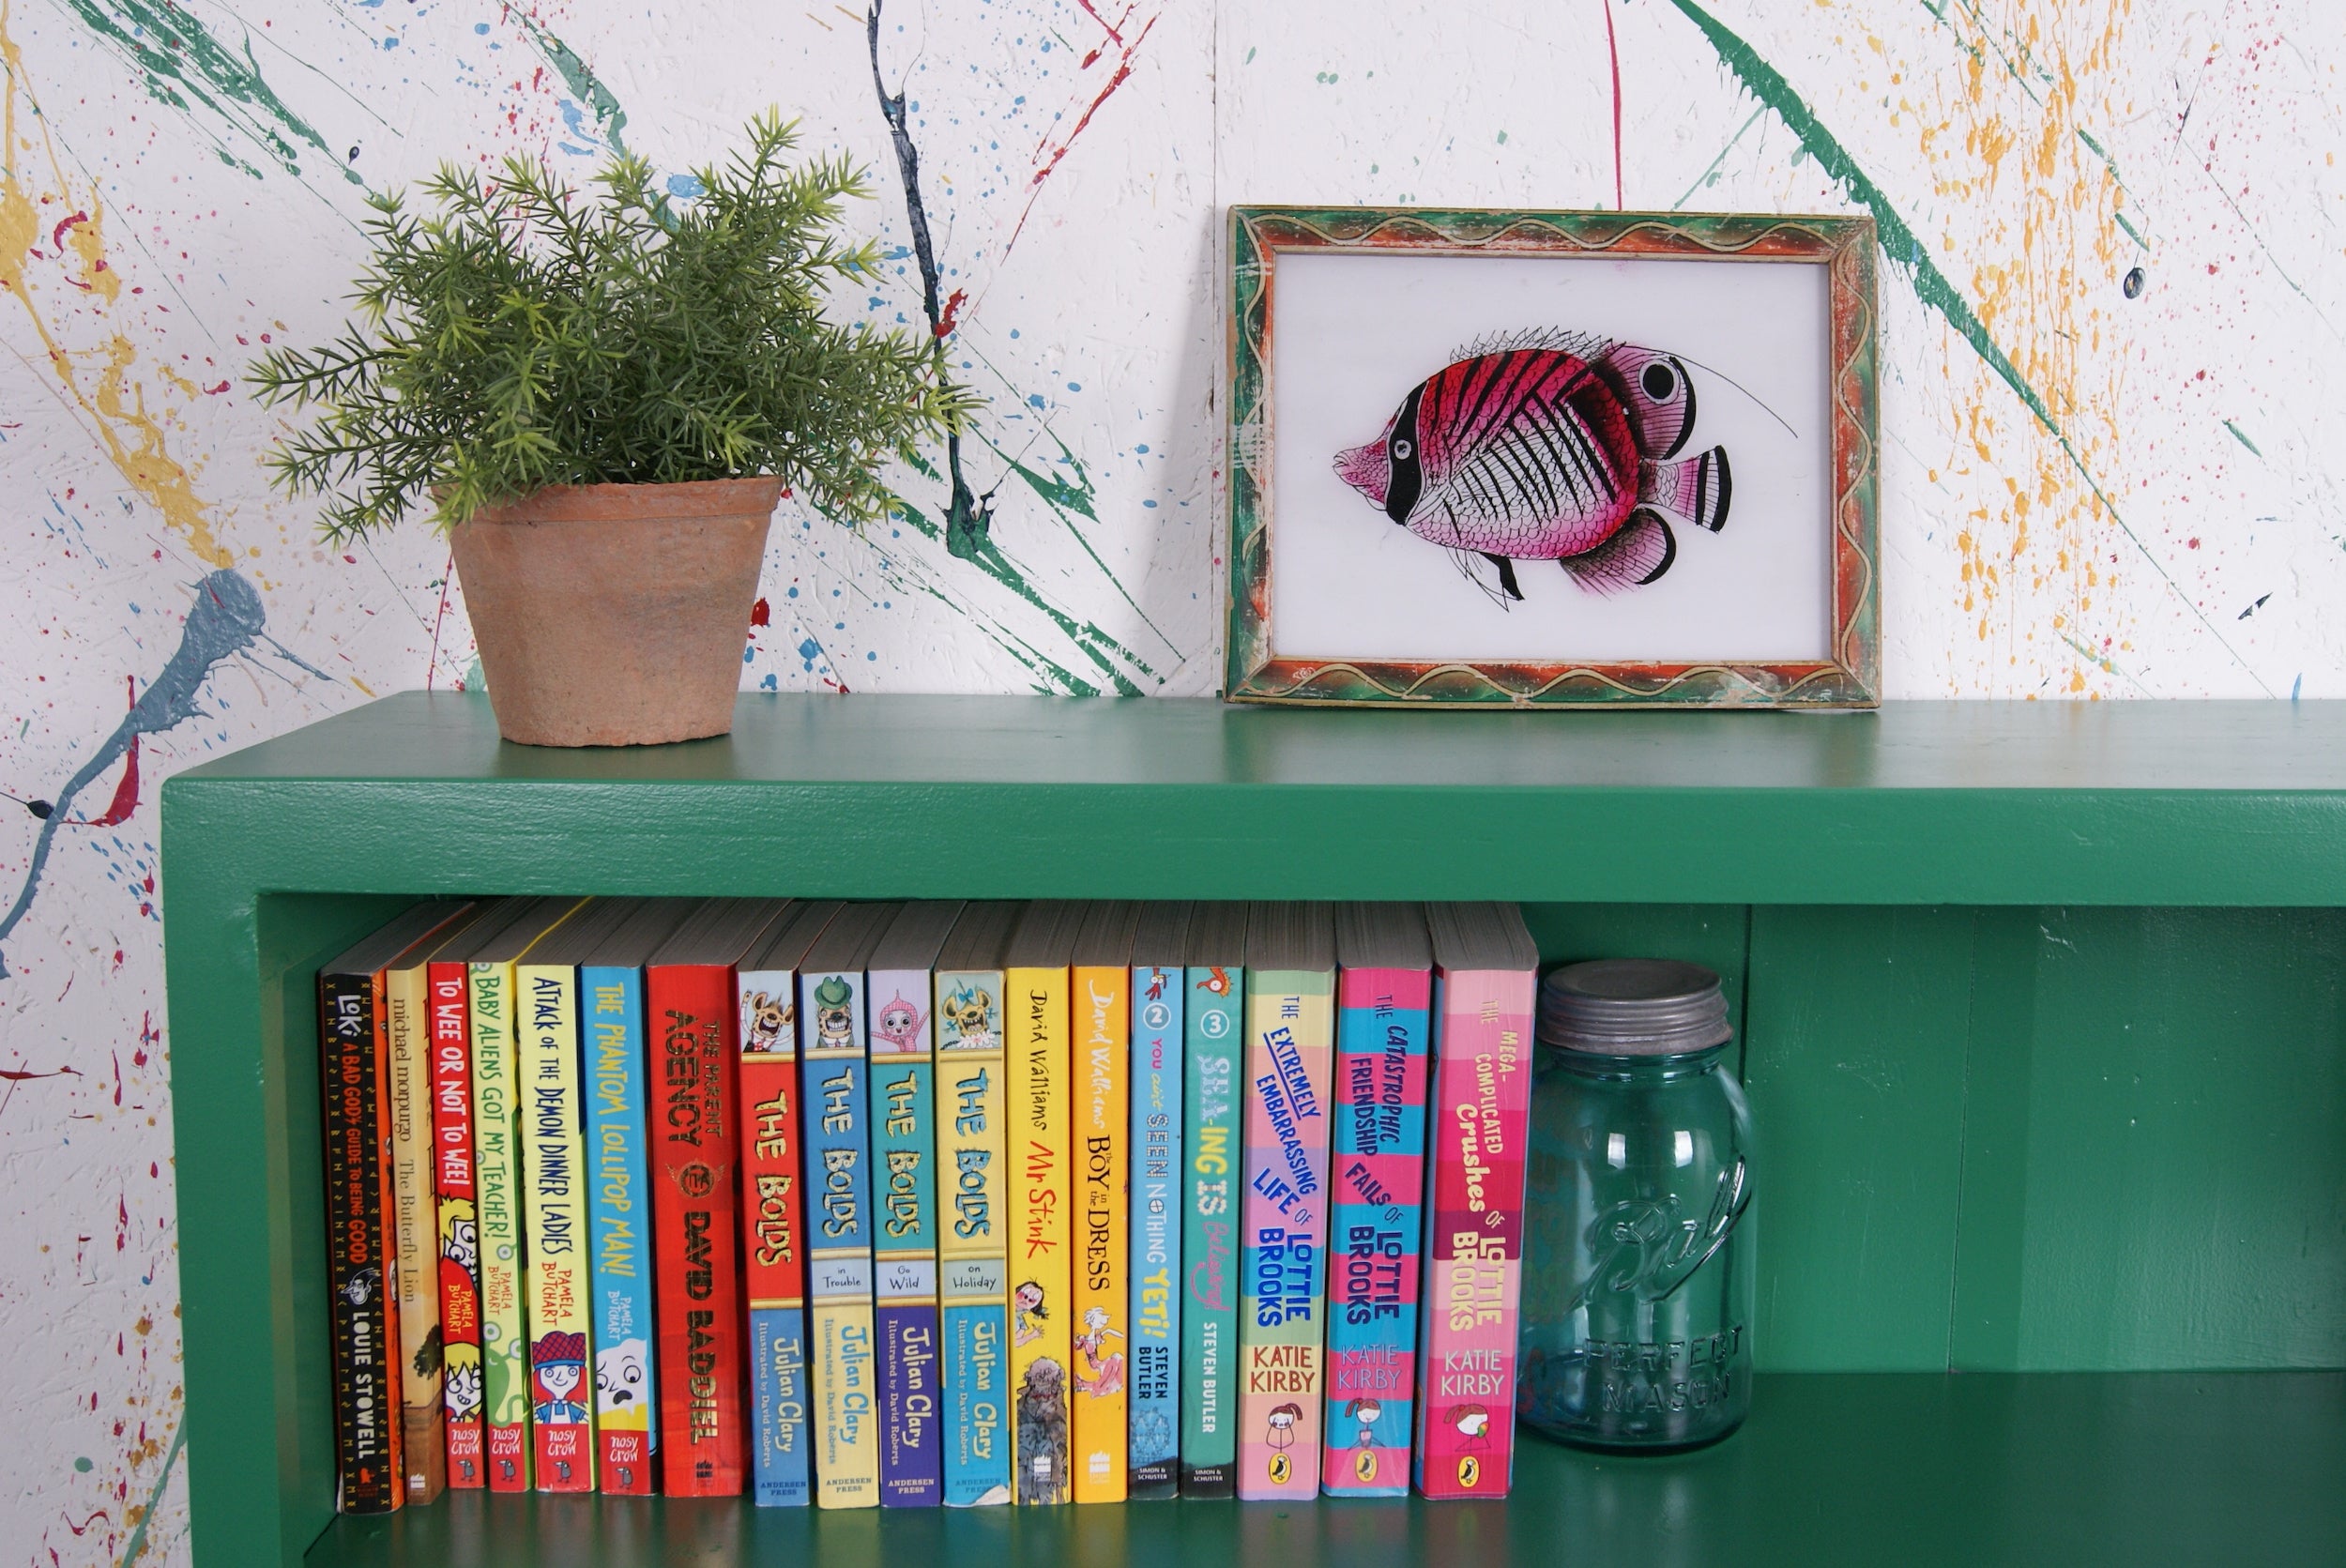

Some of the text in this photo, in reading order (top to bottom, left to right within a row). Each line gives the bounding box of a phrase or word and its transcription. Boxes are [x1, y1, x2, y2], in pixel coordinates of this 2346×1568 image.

[436, 1003, 464, 1041] WEE
[1150, 1009, 1163, 1024] 2
[1209, 1015, 1222, 1031] 3
[1282, 996, 1300, 1020] THE
[1375, 995, 1394, 1019] THE
[1481, 999, 1500, 1025] THE
[342, 1056, 361, 1084] BAD
[343, 1043, 358, 1052] A
[393, 998, 412, 1142] michael morpurgo
[439, 1046, 465, 1074] OR
[1029, 990, 1050, 1131] David Walliams
[1089, 980, 1114, 1130] David Walliams
[1151, 1038, 1163, 1070] YOU
[1270, 1027, 1321, 1119] EXTREMELY
[1499, 1029, 1518, 1082] MEGA-
[665, 1009, 702, 1148] AGENCY
[703, 1021, 724, 1138] THE PARENT
[1379, 1026, 1409, 1144] CATASTROPHIC
[1475, 1053, 1503, 1154] COMPLICATED
[476, 976, 511, 1239] BABY ALIENS GOT MY TEACHER!
[533, 977, 573, 1255] ATTACK OF THE DEMON DINNER LADIES
[594, 982, 636, 1277] THE PHANTOM LOLLIPOP MAN!
[1350, 1057, 1379, 1157] FRIENDSHIP
[346, 1128, 363, 1165] GUIDE
[821, 1066, 859, 1239] THE BOLDS
[886, 1070, 922, 1239] THE BOLDS
[953, 1067, 992, 1239] THE BOLDS
[1147, 1113, 1169, 1178] SEEN
[1256, 1074, 1318, 1195] EMBARRASSING
[442, 1148, 471, 1185] WEE!
[754, 1089, 792, 1267] THE BOLDS
[1088, 1134, 1110, 1190] BOY
[1455, 1103, 1505, 1228] Crushes OF
[349, 1183, 364, 1216] BEING
[1026, 1141, 1057, 1259] Mr Stink
[1100, 1194, 1107, 1203] in
[1196, 1180, 1227, 1216] IS
[1252, 1167, 1313, 1226] LIFE OF
[1384, 1207, 1405, 1225] OF
[348, 1220, 368, 1264] GOOD
[399, 1160, 419, 1302] The Butterfly Lion
[1146, 1183, 1167, 1264] NOTHING
[684, 1211, 713, 1301] DAVID
[897, 1266, 910, 1274] Go
[1088, 1210, 1110, 1291] DRESS
[1347, 1225, 1375, 1325] BROOKS
[1374, 1230, 1403, 1319] LOTTIE
[500, 1271, 512, 1310] PAMELA
[557, 1269, 574, 1318] PAMELA
[823, 1276, 861, 1288] Trouble
[890, 1277, 919, 1290] Wild
[952, 1276, 997, 1291] Holiday
[1257, 1227, 1285, 1328] BROOKS
[1286, 1233, 1312, 1322] LOTTIE
[1449, 1231, 1479, 1332] BROOKS
[1476, 1236, 1506, 1327] LOTTIE
[461, 1290, 474, 1328] PAMELA
[619, 1297, 633, 1334] PAMELA
[1138, 1347, 1151, 1399] BUTLER
[1155, 1347, 1168, 1399] STEVEN
[1254, 1346, 1313, 1368] KATIE
[1341, 1344, 1399, 1365] KATIE
[1444, 1350, 1502, 1372] KATIE
[1584, 1325, 1743, 1372] PERFECT
[353, 1311, 375, 1459] LOUIE STOWELL
[687, 1310, 719, 1445] BADDIEL
[759, 1322, 770, 1468] Illustrated by David Roberts
[773, 1338, 803, 1453] Julian Clary
[839, 1325, 871, 1445] Julian Clary
[889, 1319, 899, 1466] Illustrated by David Roberts
[902, 1327, 933, 1448] Julian Clary
[972, 1321, 997, 1459] Julian Clary
[1202, 1322, 1217, 1434] STEVEN BUTLER
[1250, 1371, 1316, 1393] KIRBY
[1338, 1369, 1402, 1391] KIRBY
[1440, 1375, 1504, 1396] KIRBY
[1603, 1372, 1731, 1413] MASON
[451, 1428, 480, 1441] nosy
[493, 1428, 521, 1441] nosy
[548, 1430, 576, 1442] nosy
[611, 1436, 639, 1450] nosy
[761, 1481, 806, 1489] ANDERSEN
[826, 1478, 872, 1486] ANDERSEN
[888, 1478, 935, 1487] ANDERSEN
[898, 1485, 925, 1494] PRESS
